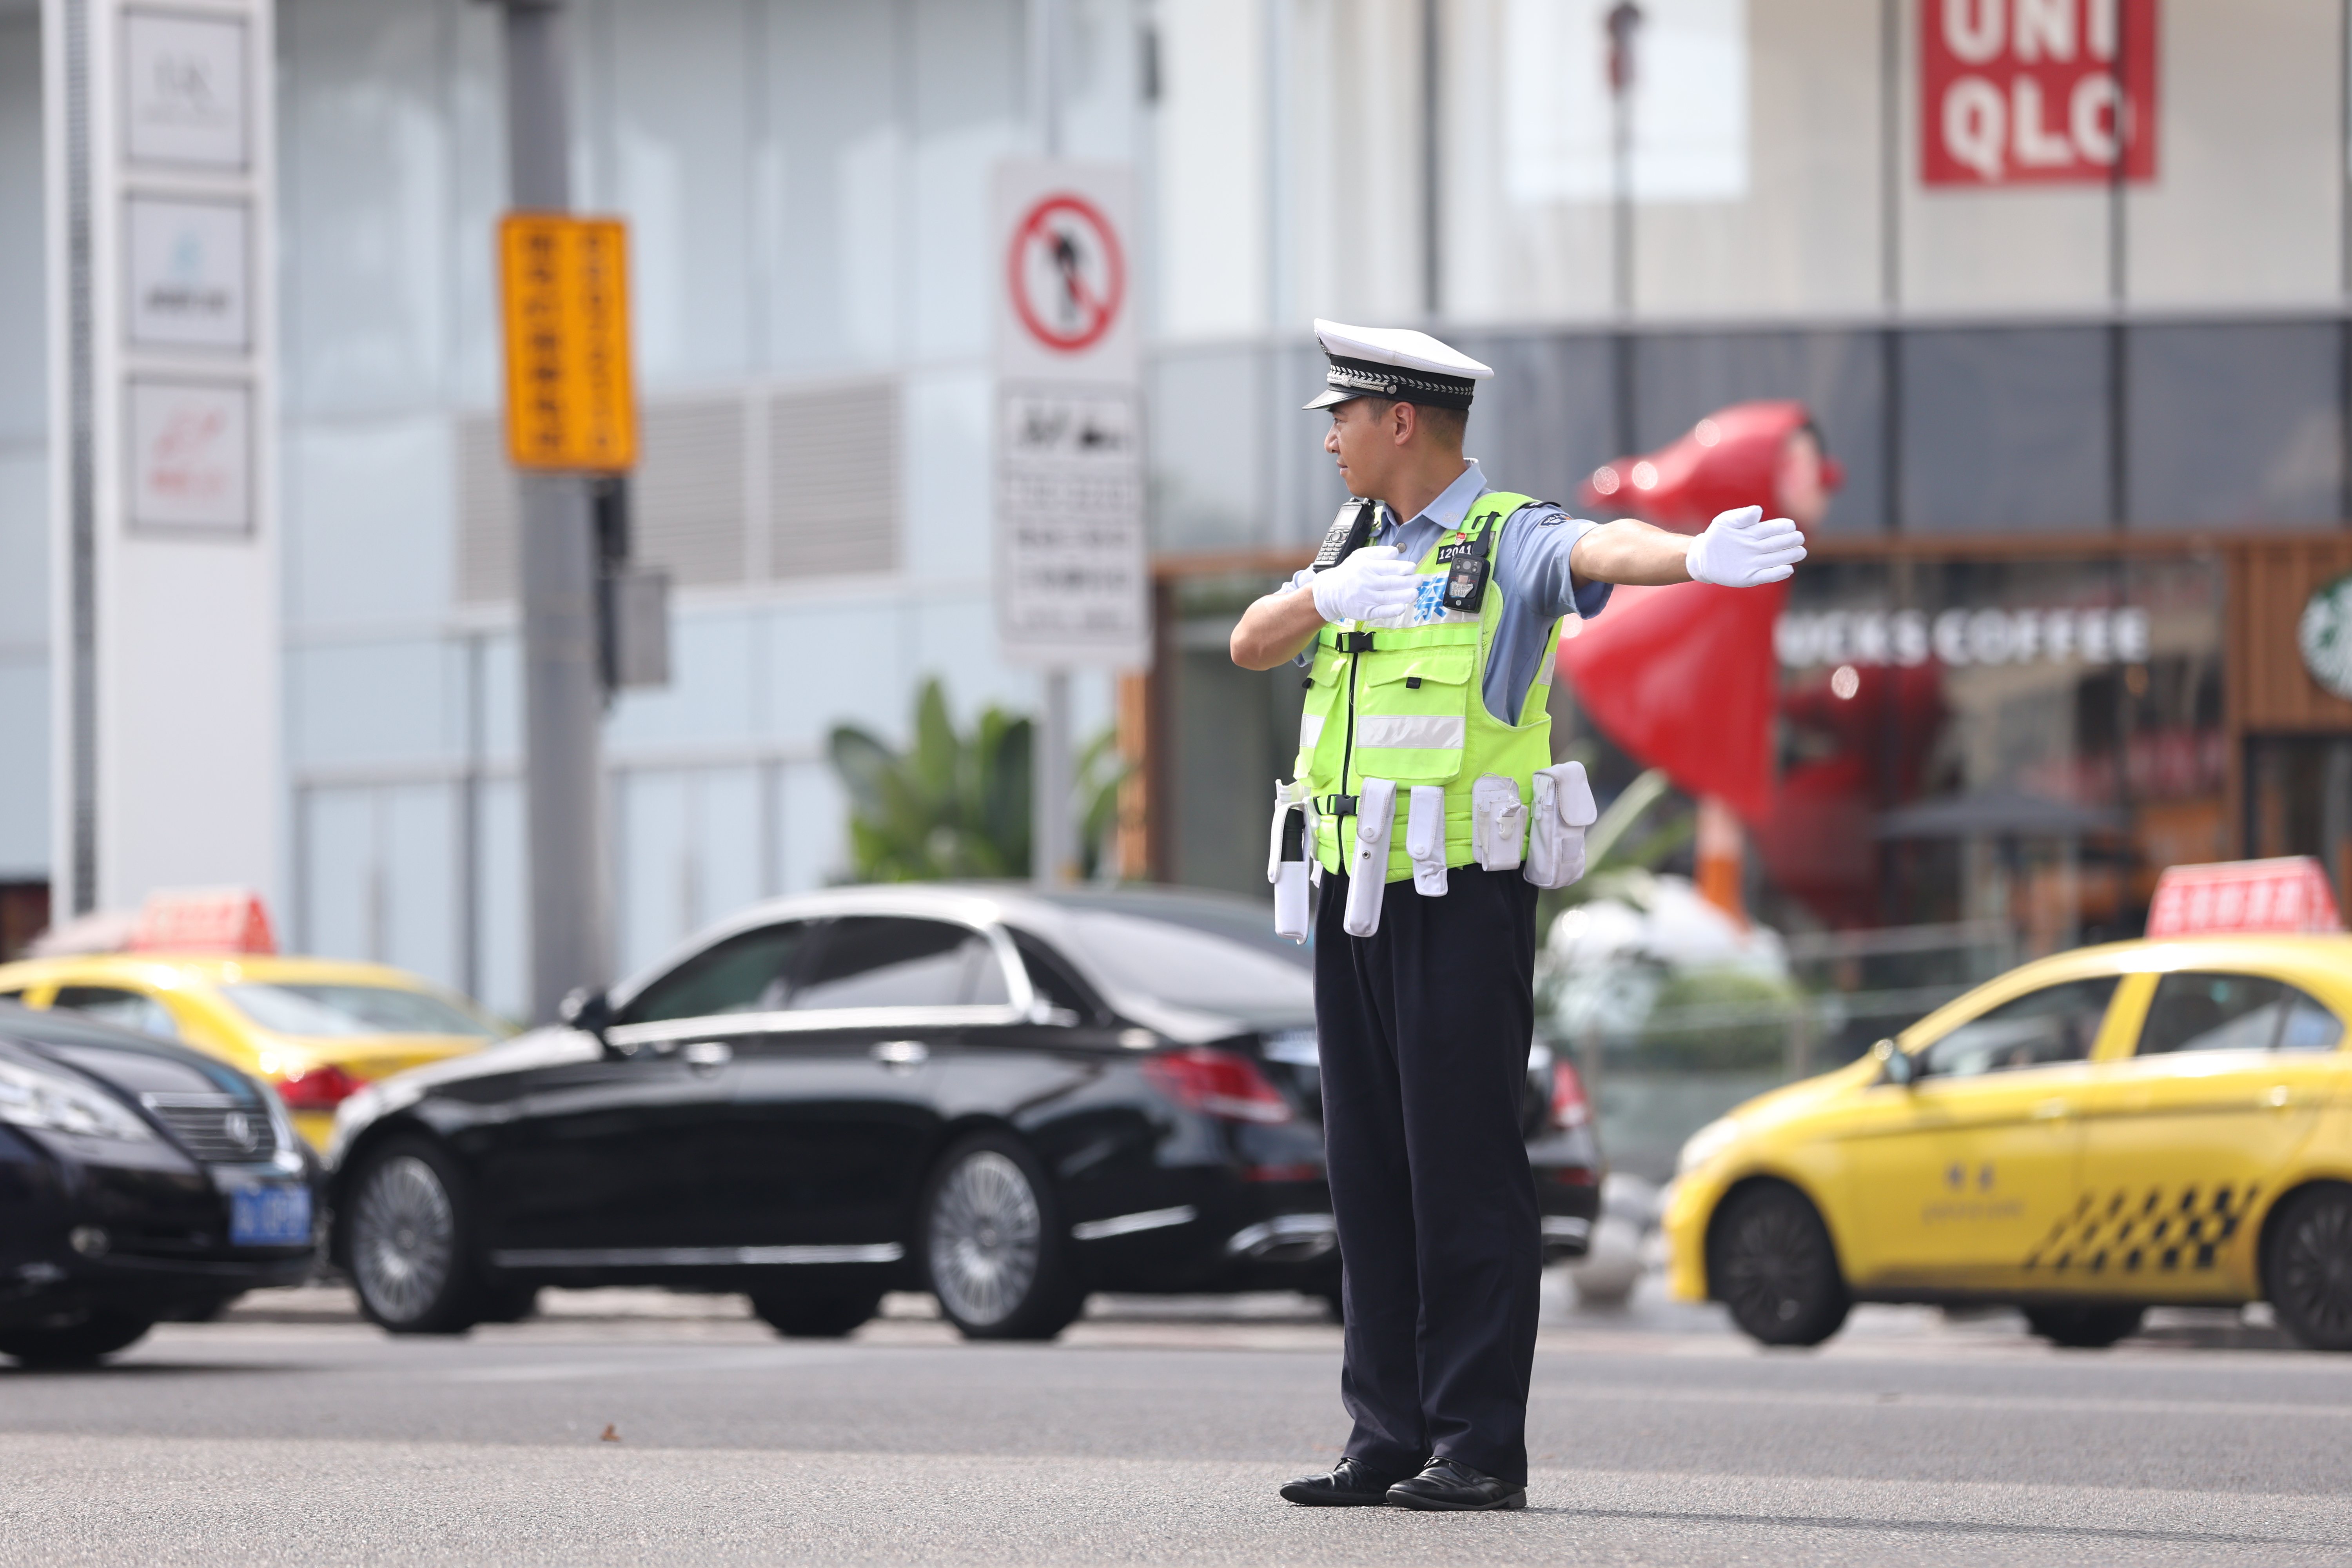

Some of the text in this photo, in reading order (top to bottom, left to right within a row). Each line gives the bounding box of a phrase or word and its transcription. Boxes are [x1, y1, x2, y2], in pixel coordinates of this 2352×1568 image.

[1941, 0, 2119, 65] UNI
[1941, 73, 2137, 183] QLO
[1439, 545, 1472, 560] 12041
[1933, 606, 2151, 667] COFFEE
